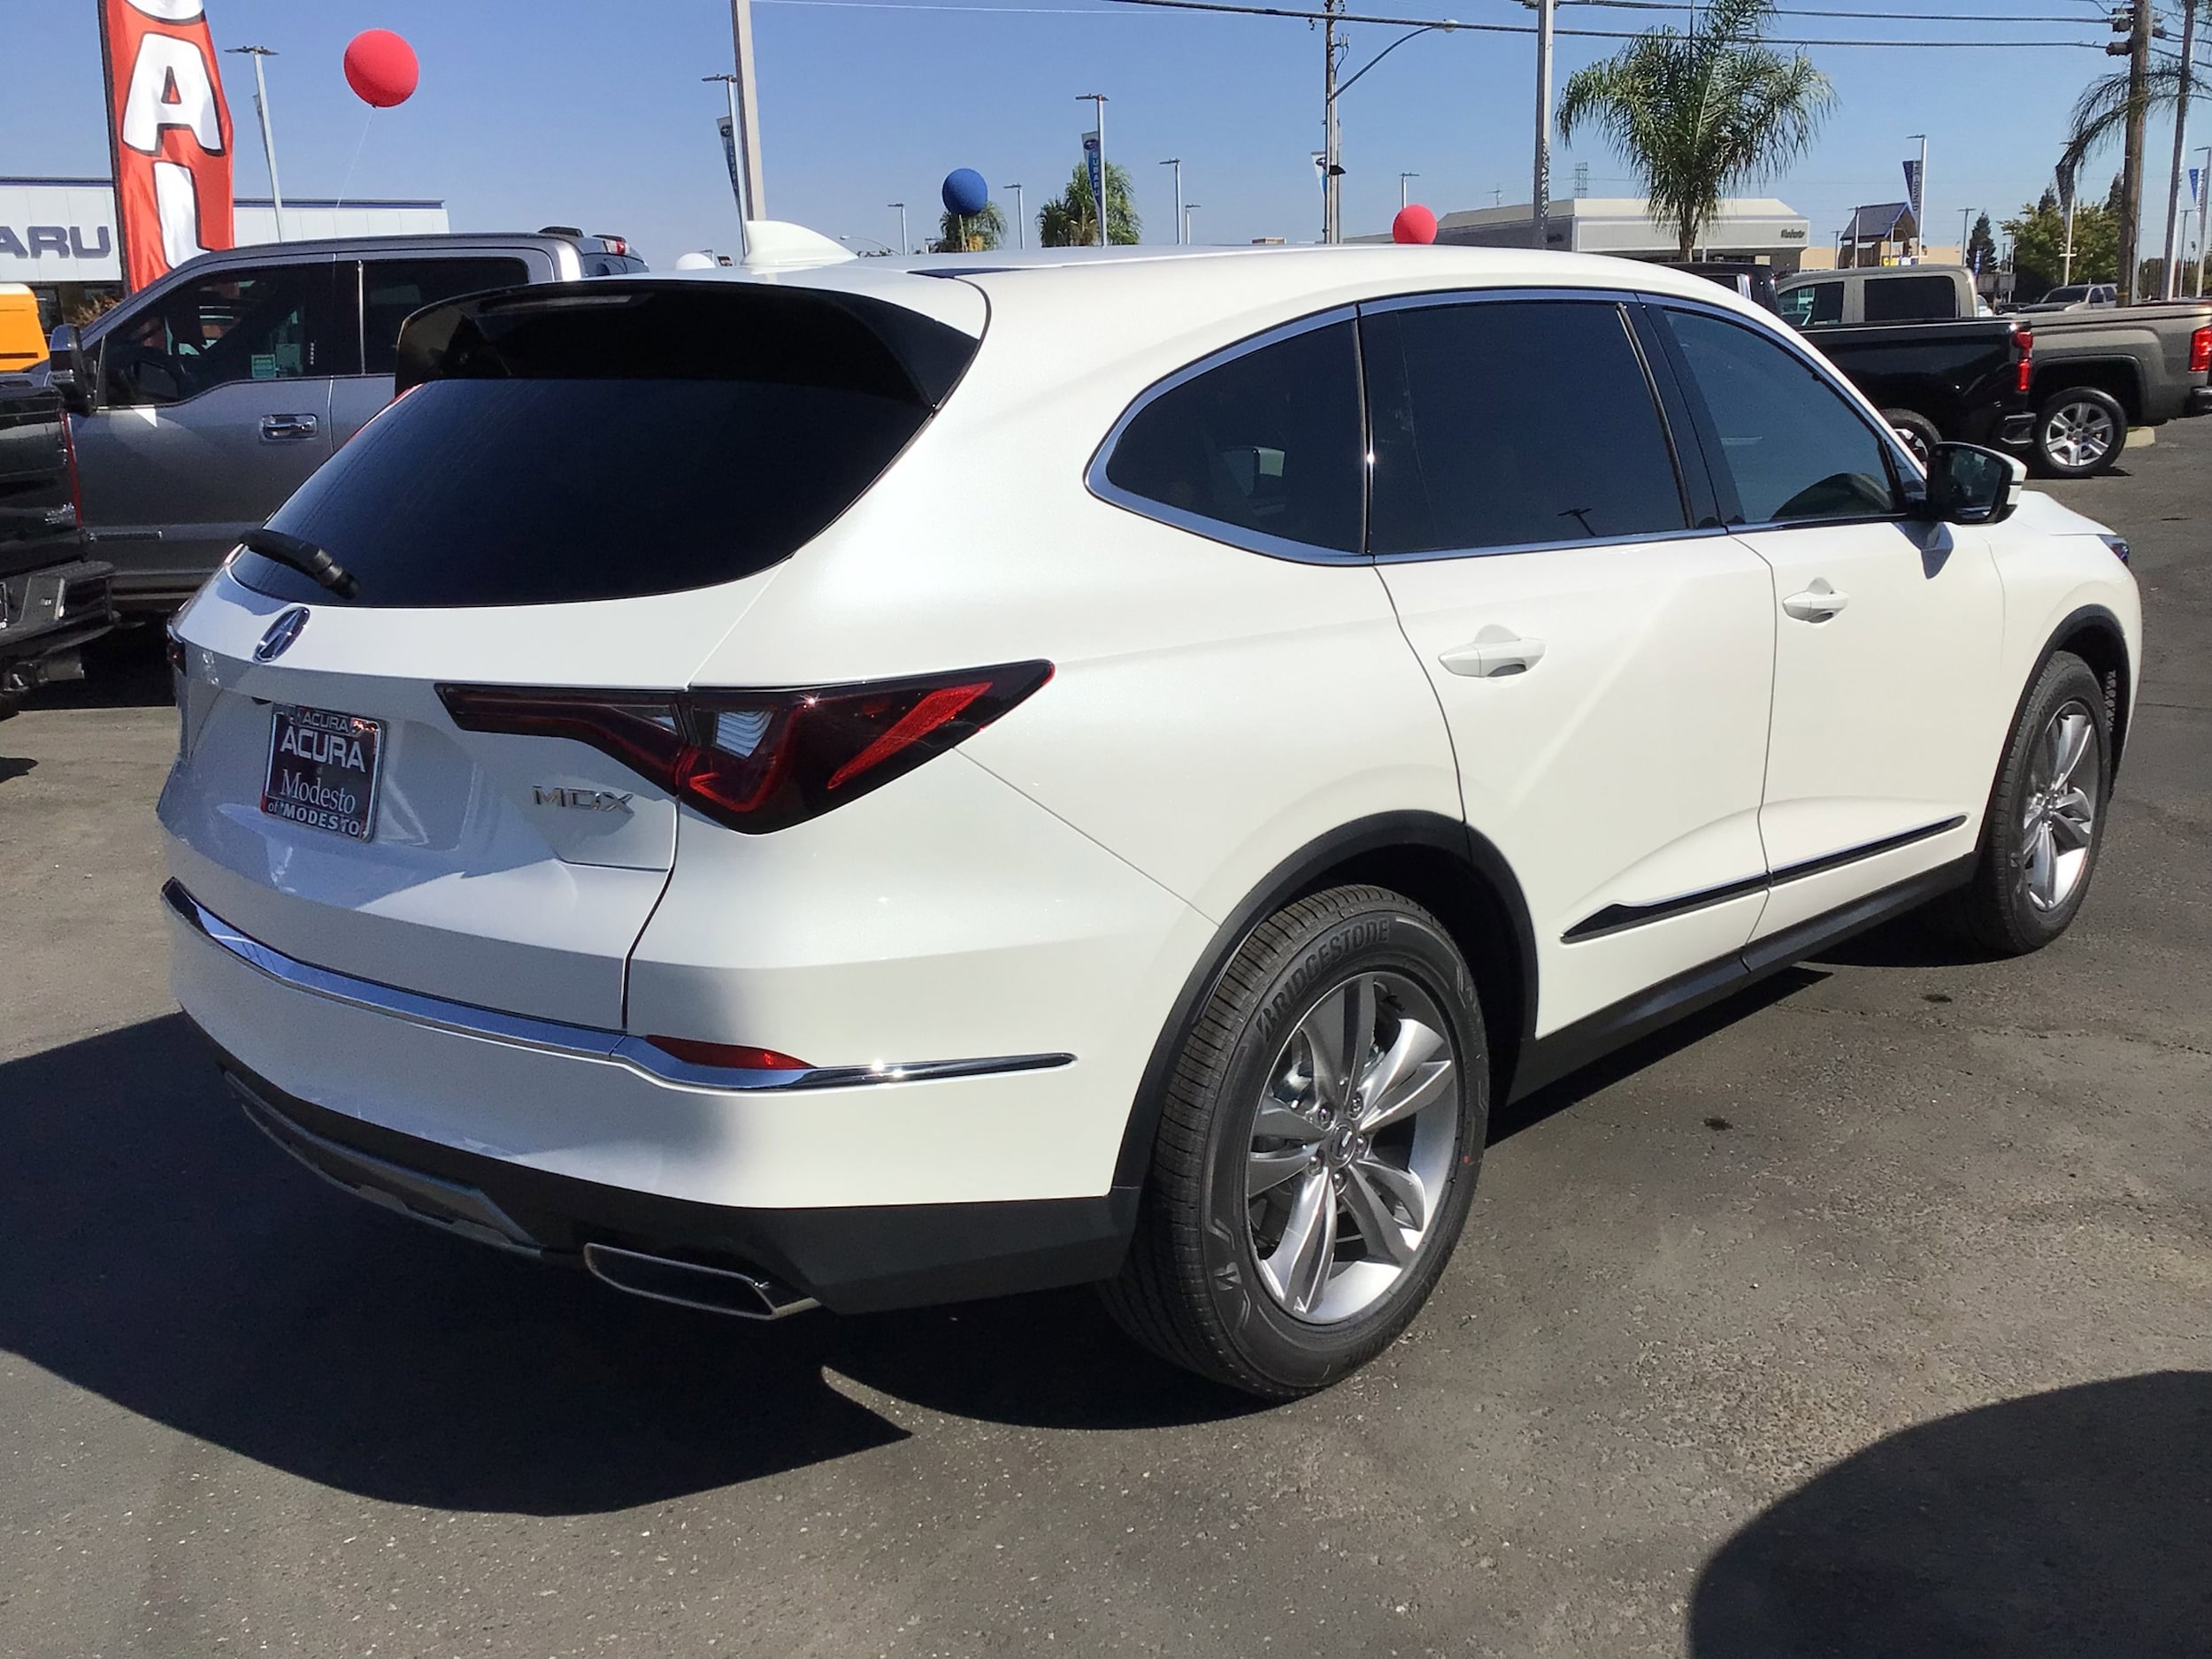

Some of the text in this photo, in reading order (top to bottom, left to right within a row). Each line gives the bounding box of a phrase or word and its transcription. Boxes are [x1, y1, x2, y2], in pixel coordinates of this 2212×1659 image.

[303, 711, 349, 733] ACURA
[280, 726, 366, 773] ACURA
[280, 769, 356, 814] Modesto
[532, 785, 634, 814] MDX
[282, 803, 360, 835] MODESTO
[1256, 918, 1390, 1041] BRIDGESTONE
